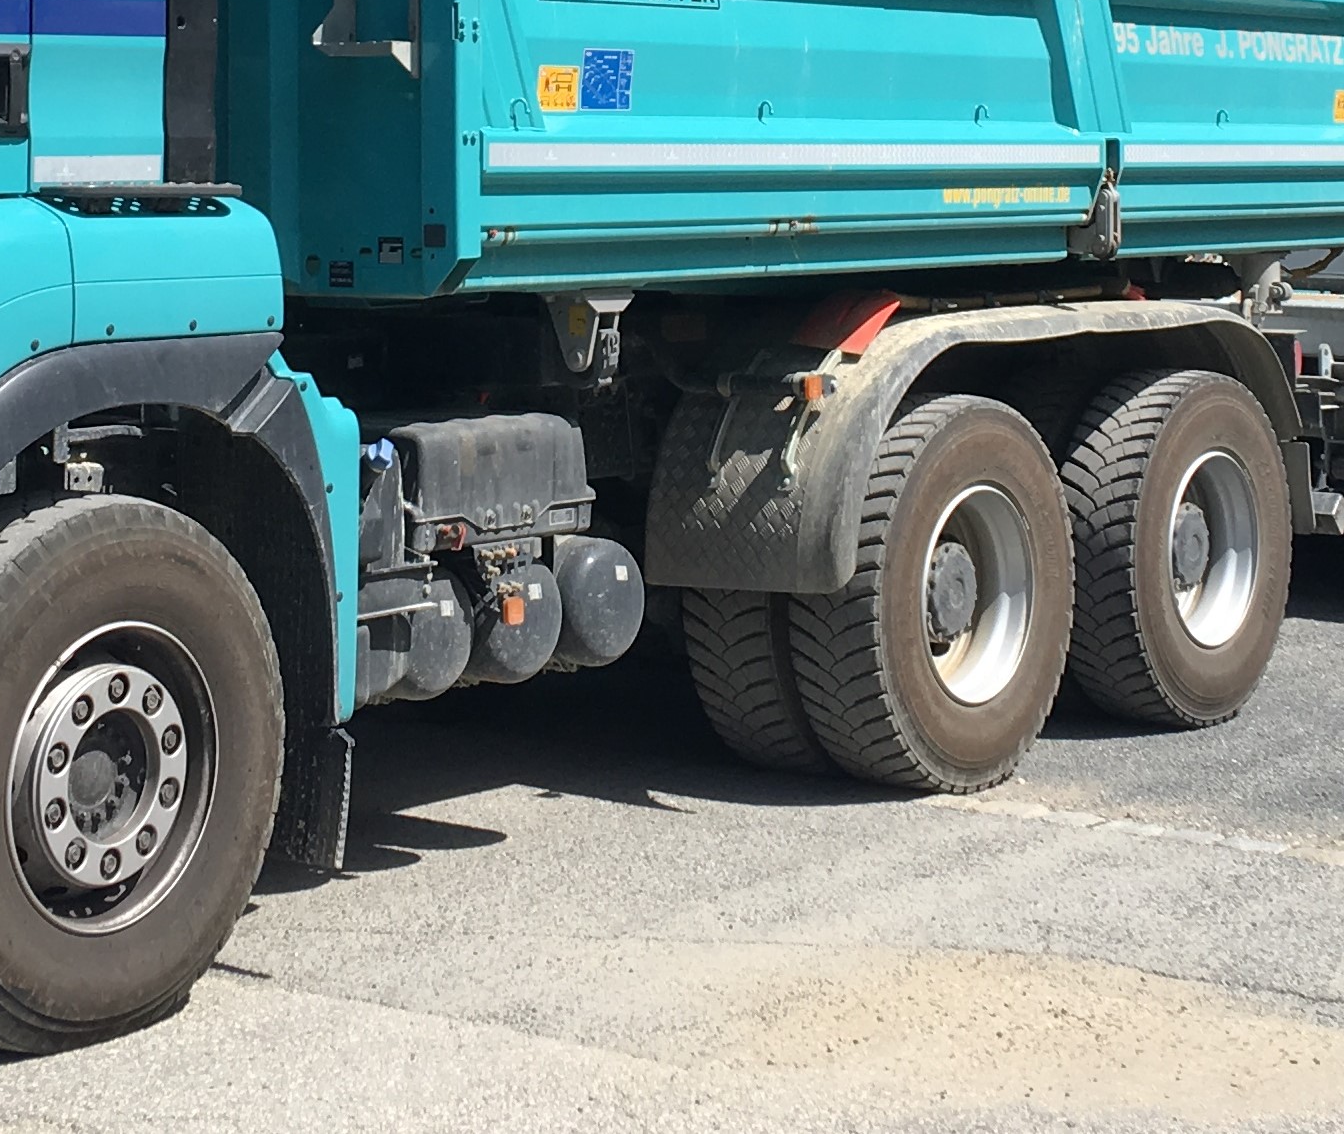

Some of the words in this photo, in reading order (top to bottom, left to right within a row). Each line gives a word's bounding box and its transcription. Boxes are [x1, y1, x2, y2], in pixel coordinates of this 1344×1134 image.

[1113, 22, 1140, 54] 95
[1145, 25, 1205, 57] Jahre
[1215, 29, 1235, 59] J.
